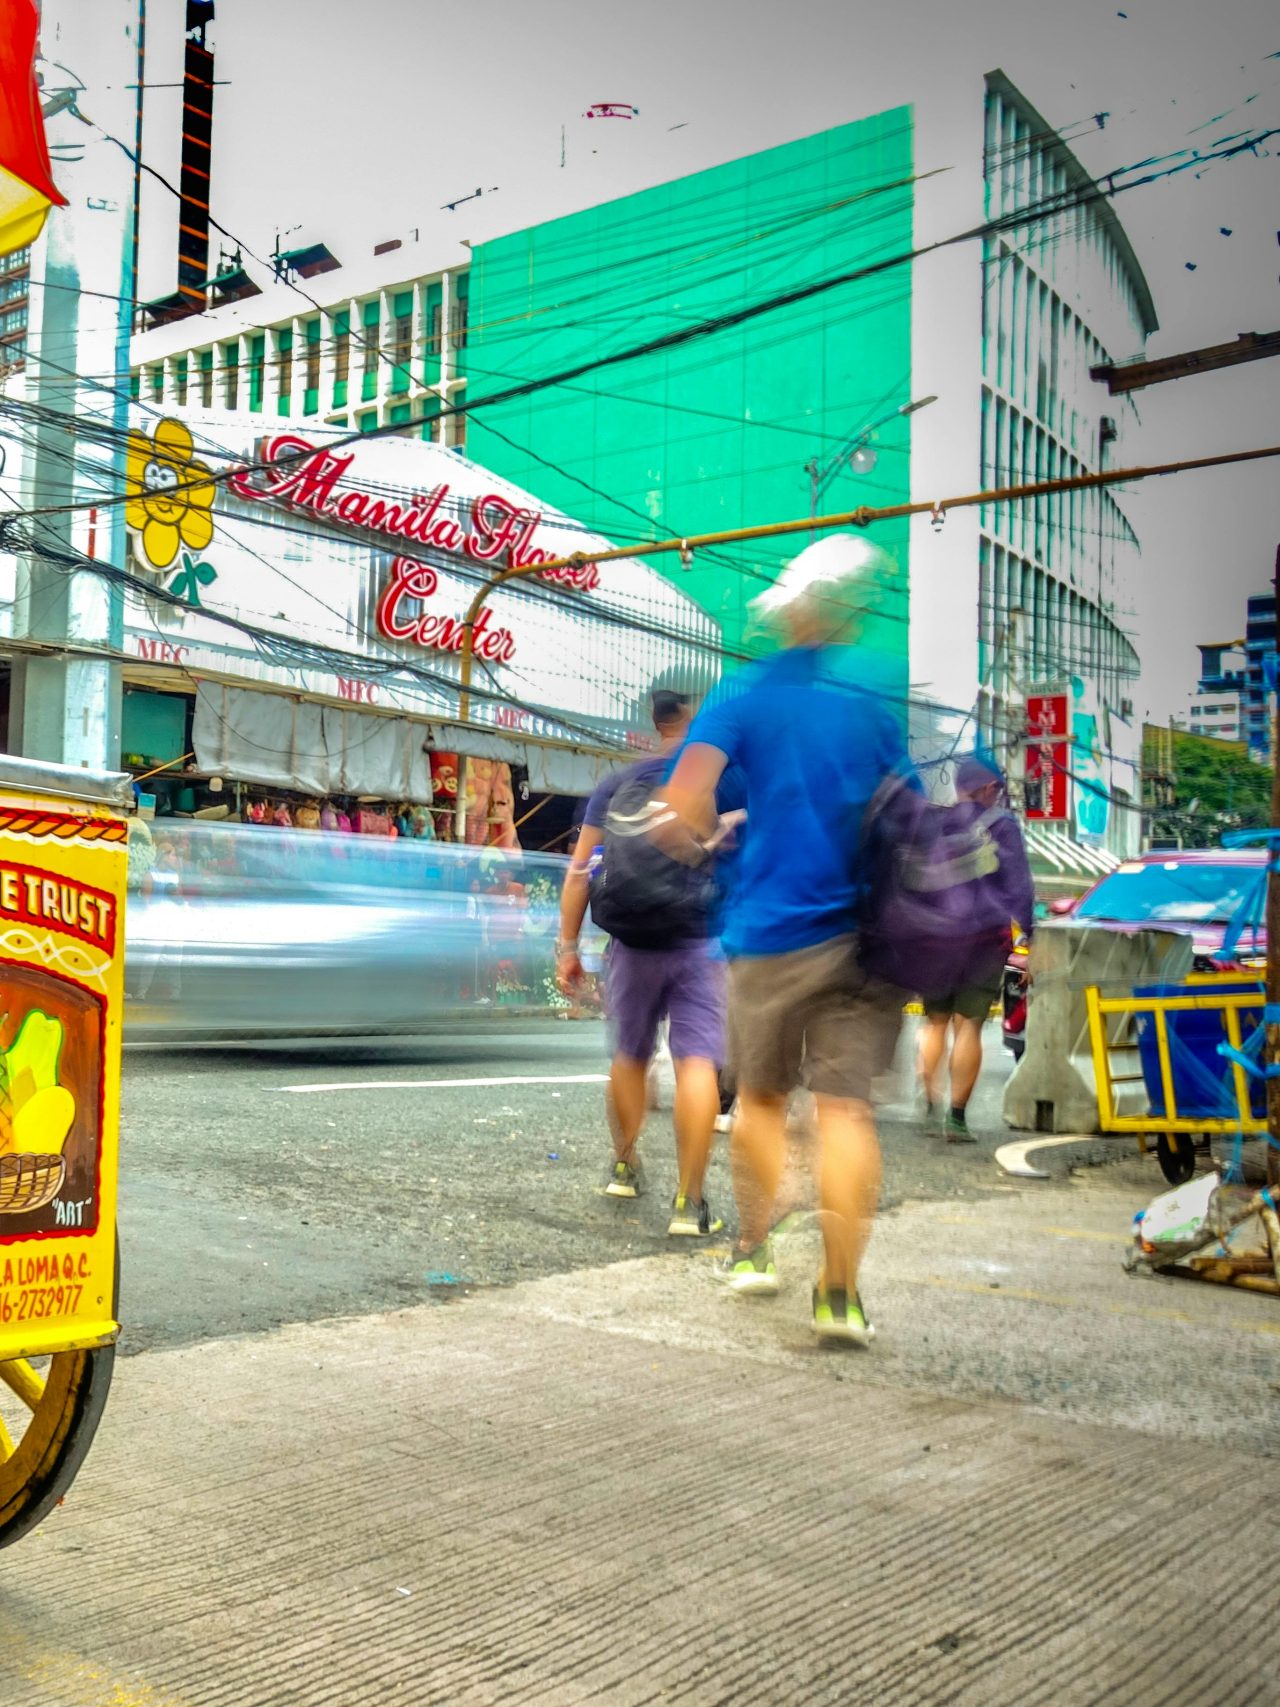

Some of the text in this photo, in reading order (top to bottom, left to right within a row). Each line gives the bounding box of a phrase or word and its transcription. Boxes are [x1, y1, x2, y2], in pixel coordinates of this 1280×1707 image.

[226, 435, 464, 549] Manila
[376, 554, 517, 664] Center
[336, 676, 381, 705] MFC
[23, 875, 111, 941] TRUST
[18, 1254, 59, 1286] LOMA
